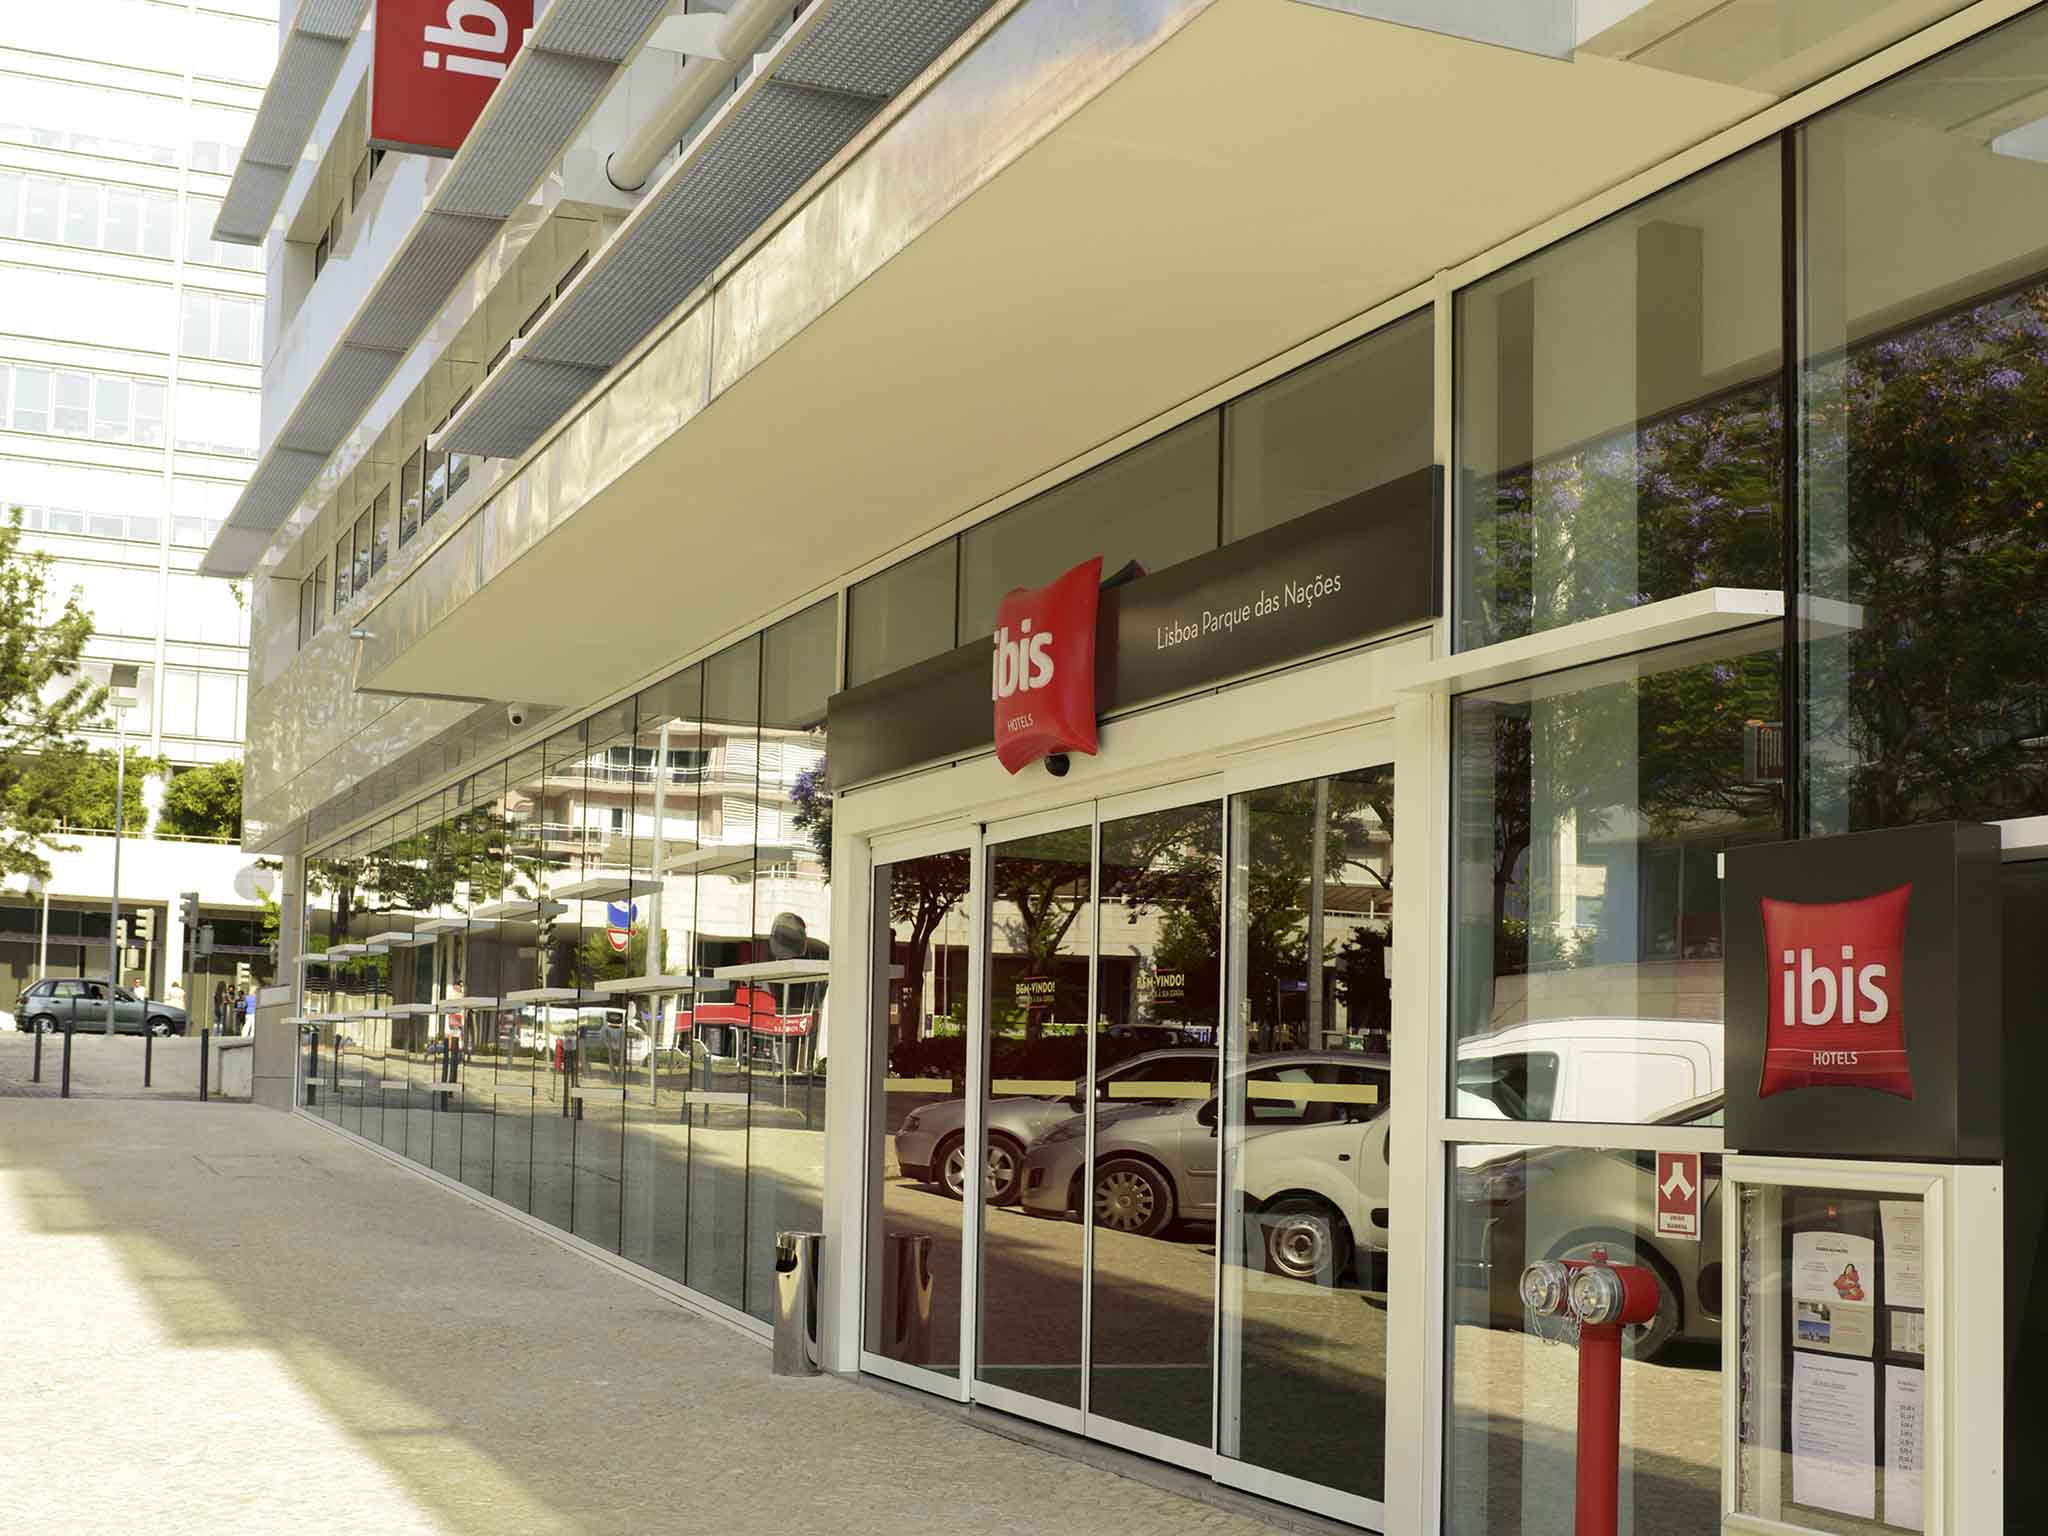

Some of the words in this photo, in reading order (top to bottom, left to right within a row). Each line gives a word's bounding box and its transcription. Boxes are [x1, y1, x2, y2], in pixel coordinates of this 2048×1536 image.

[1157, 622, 1199, 650] Lisboa
[1202, 605, 1251, 636] Parque
[1254, 590, 1280, 618] das
[1284, 572, 1342, 608] Nações
[991, 618, 1055, 702] ibis
[1007, 712, 1034, 732] HOTELS
[1782, 944, 1889, 1027] ibis
[1812, 1051, 1859, 1066] HOTELS
